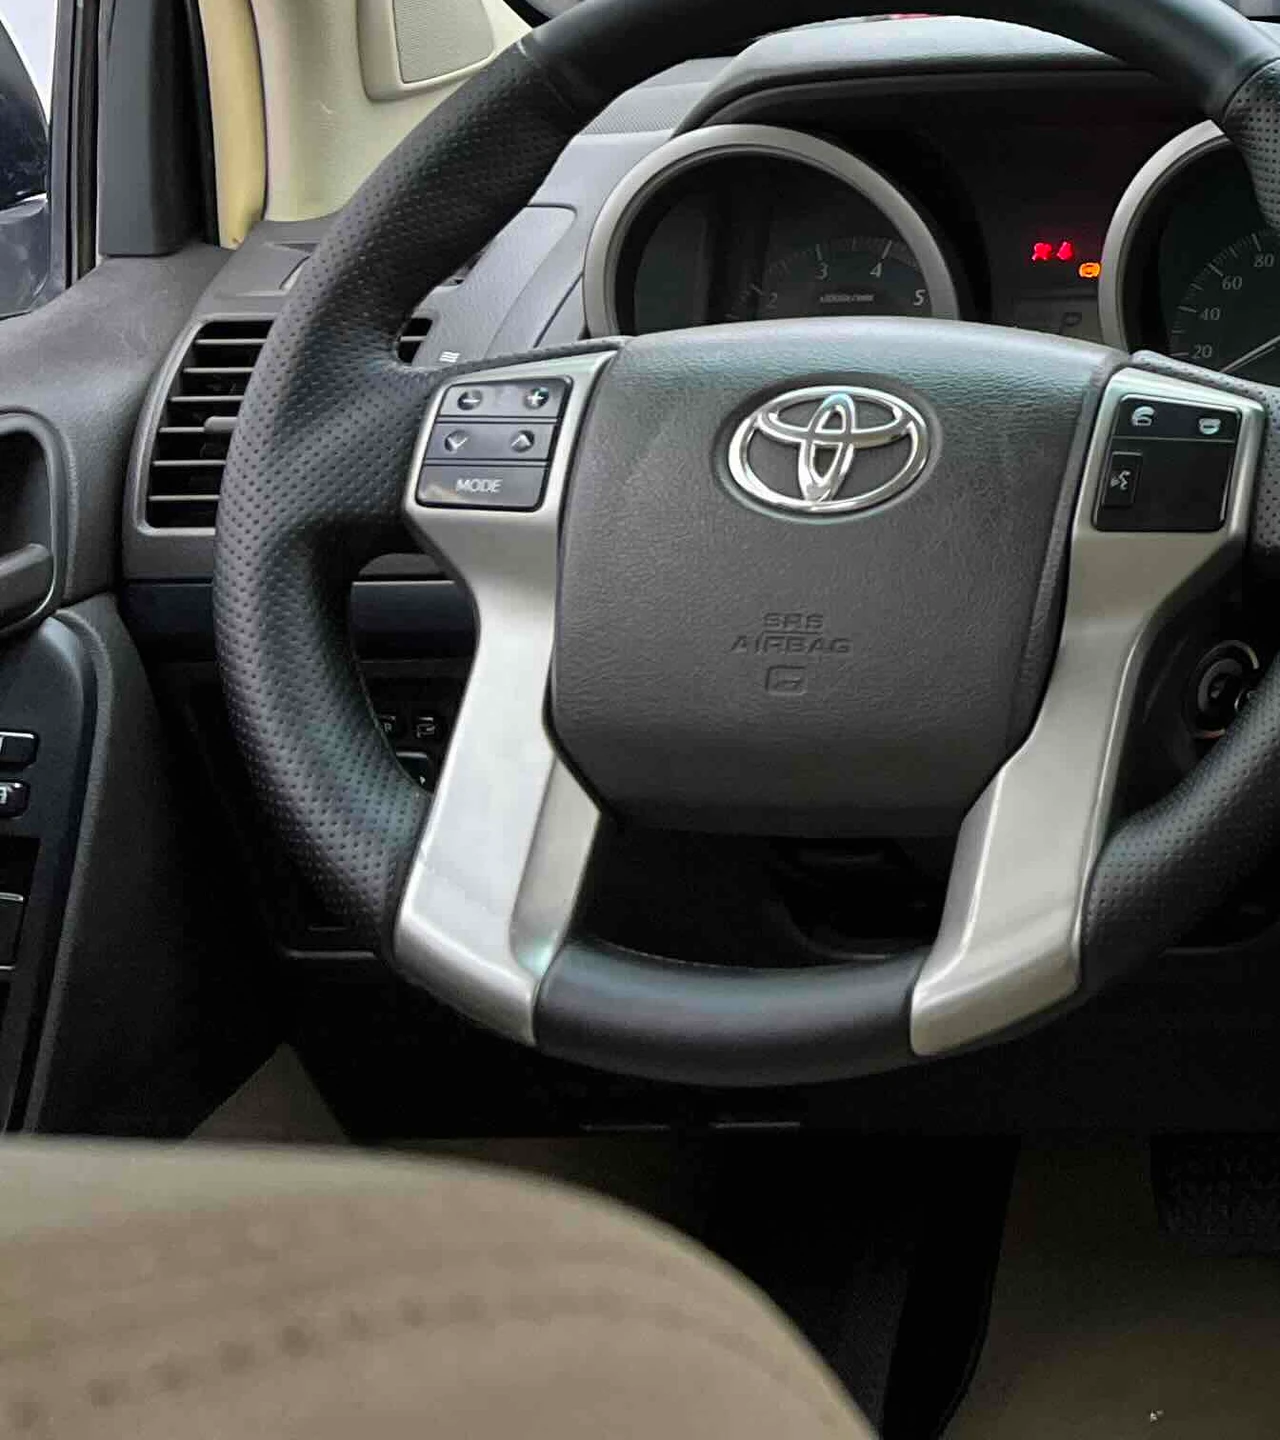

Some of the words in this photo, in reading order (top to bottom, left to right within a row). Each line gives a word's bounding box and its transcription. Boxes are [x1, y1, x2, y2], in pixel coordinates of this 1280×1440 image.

[815, 262, 829, 280] 3
[869, 262, 883, 278] 4
[1222, 275, 1243, 290] 60
[913, 289, 926, 306] 5
[1192, 344, 1213, 359] 20
[456, 478, 503, 493] MODE
[730, 635, 852, 653] AIRBAG
